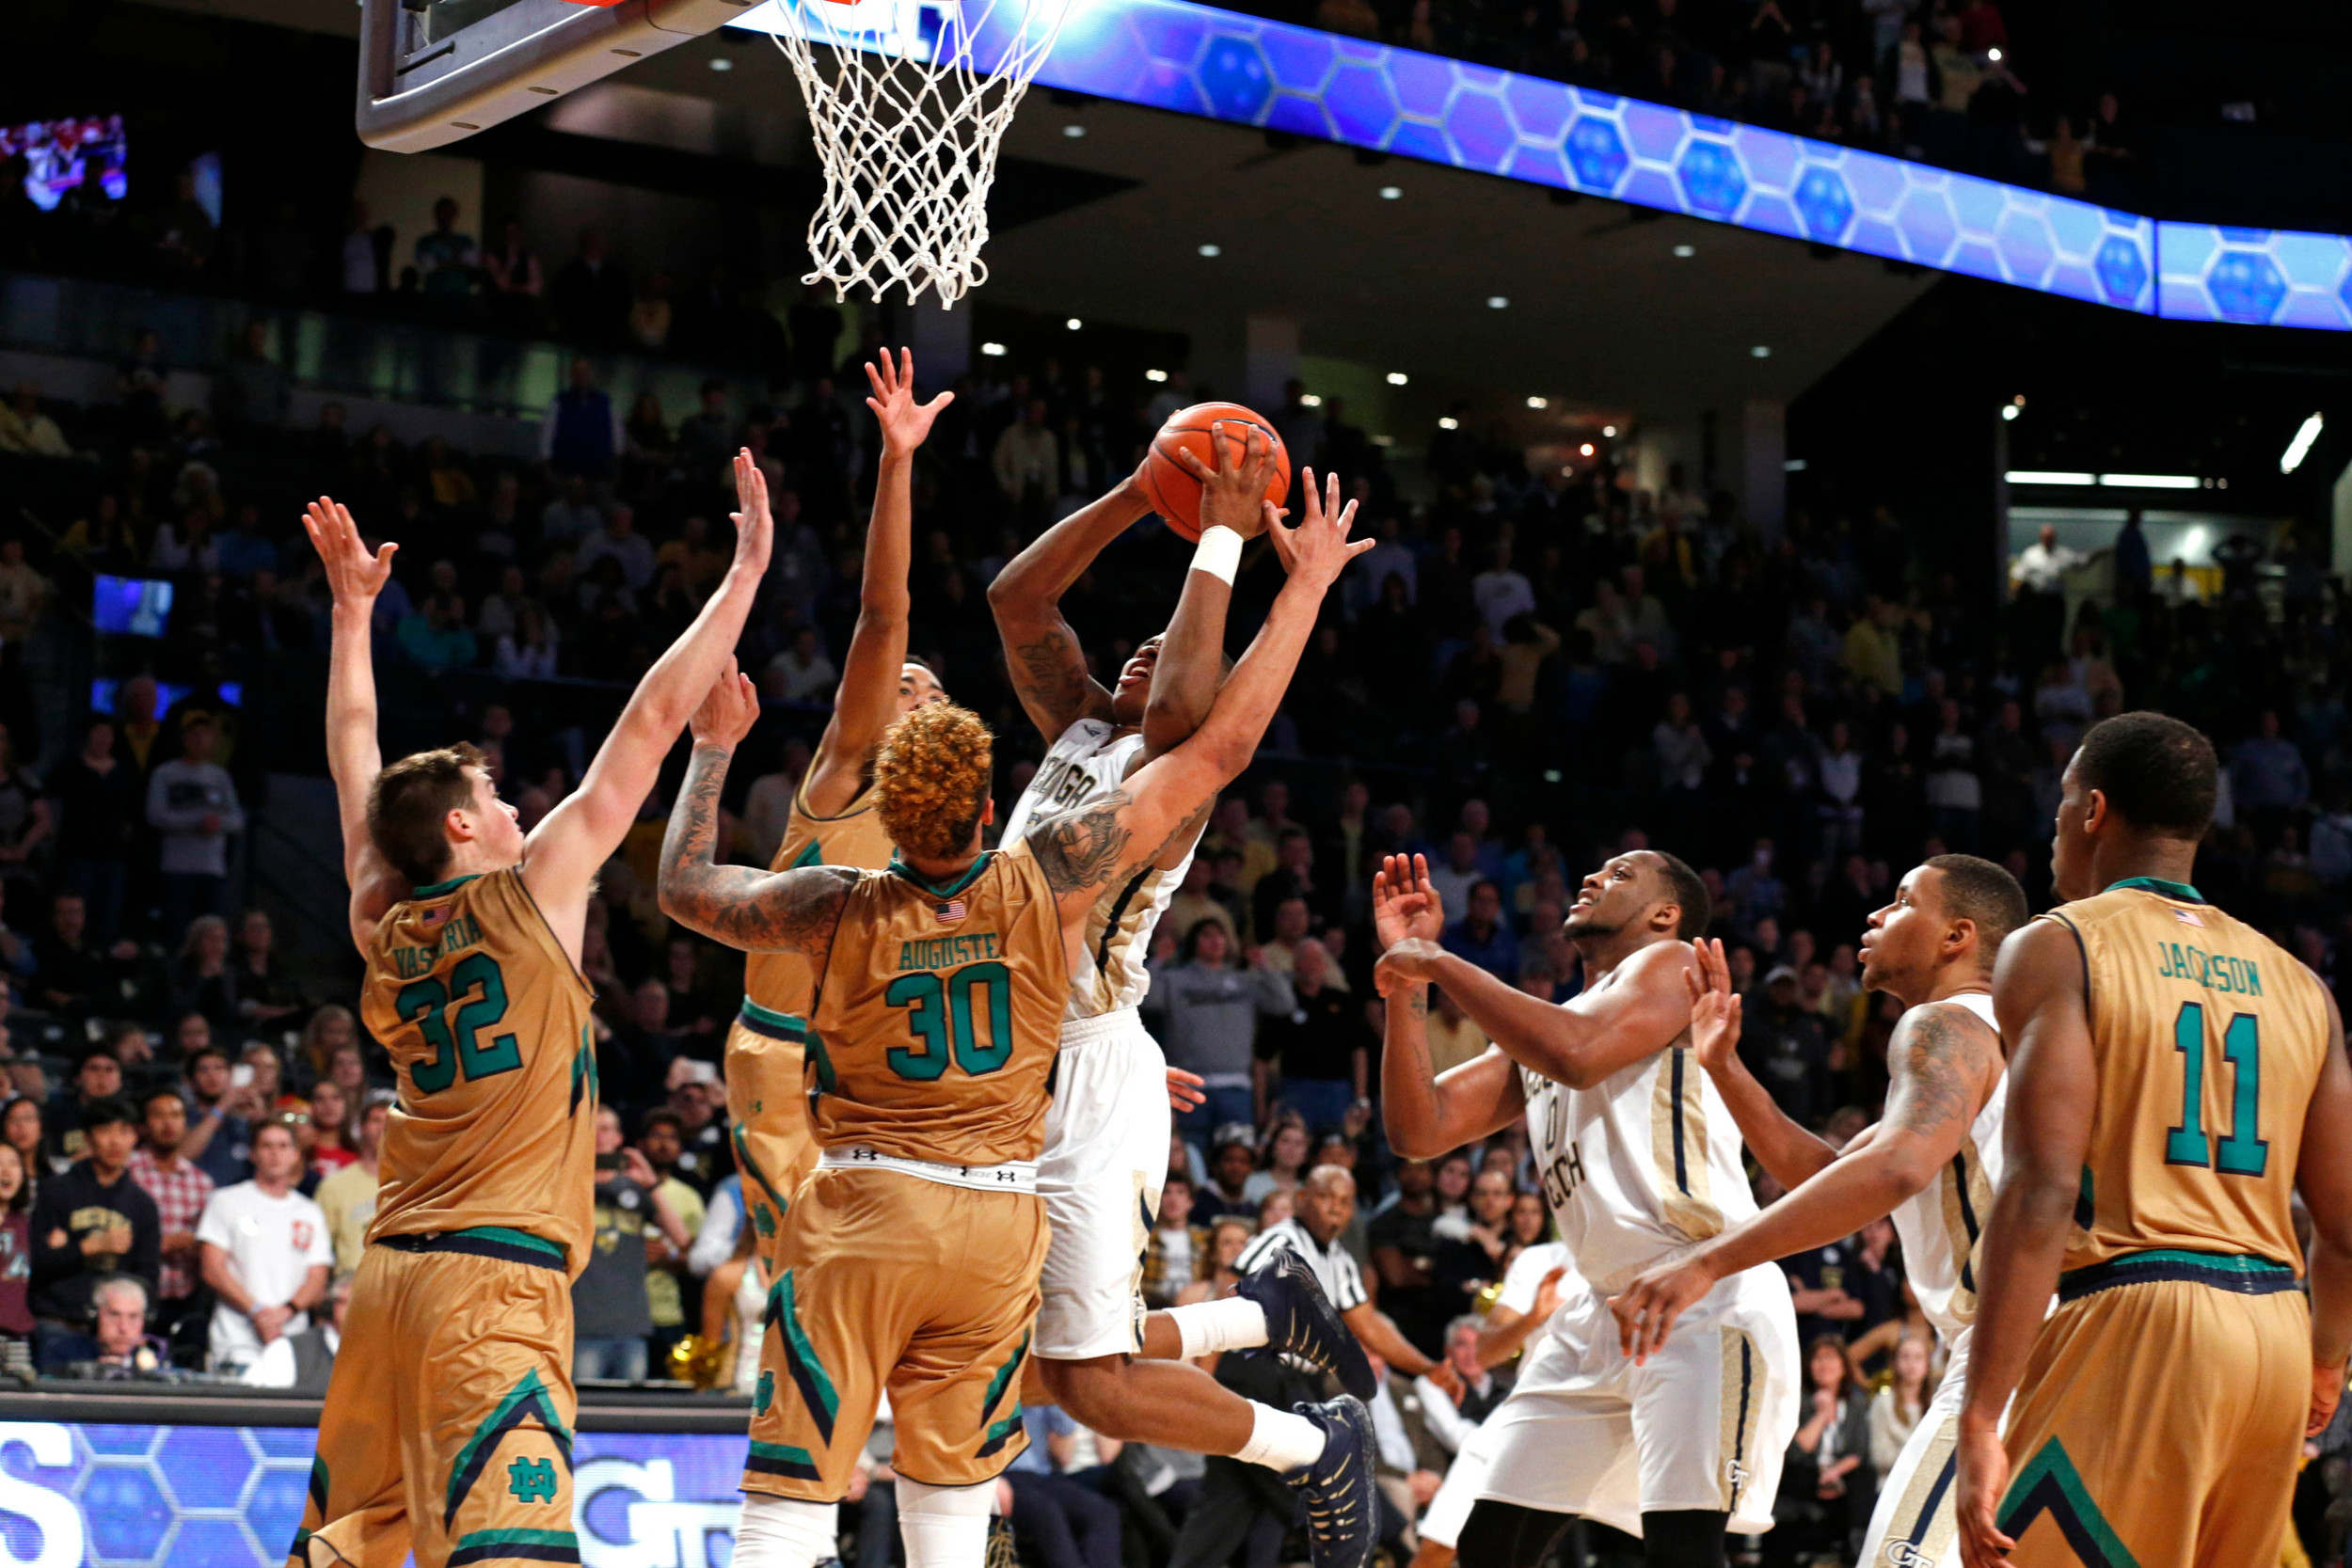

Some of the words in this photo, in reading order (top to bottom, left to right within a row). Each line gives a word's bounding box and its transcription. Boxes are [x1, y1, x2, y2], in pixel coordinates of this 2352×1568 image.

[898, 932, 1000, 971] AUGUSTE
[394, 951, 524, 1095] 32
[884, 961, 1013, 1081] 30
[2165, 1000, 2269, 1178] 11
[1544, 1141, 1586, 1210] ECH
